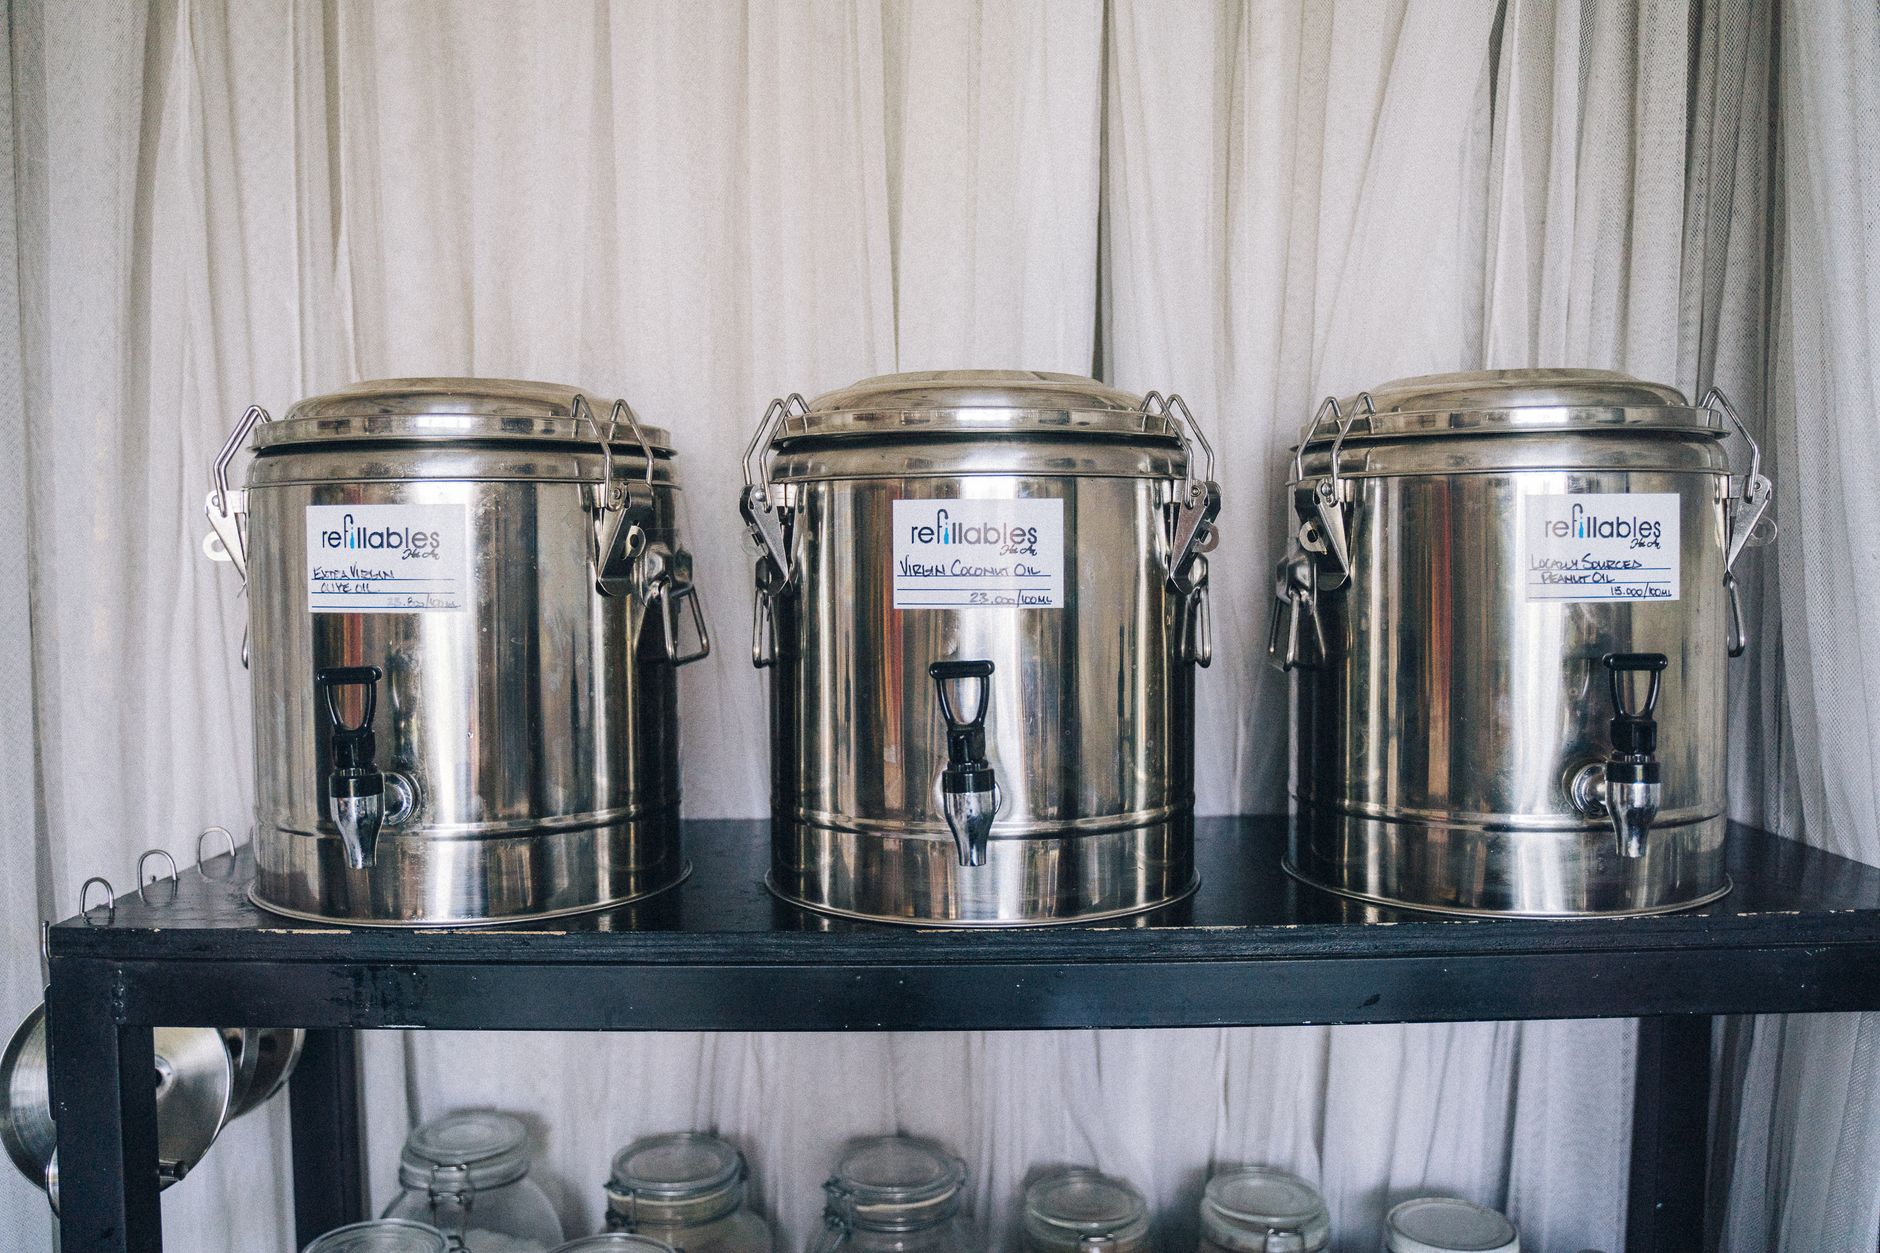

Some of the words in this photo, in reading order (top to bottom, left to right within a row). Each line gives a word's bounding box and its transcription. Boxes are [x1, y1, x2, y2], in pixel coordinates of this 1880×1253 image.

[322, 514, 440, 550] refillables
[911, 508, 1037, 545] refillables
[1545, 503, 1661, 538] refillables
